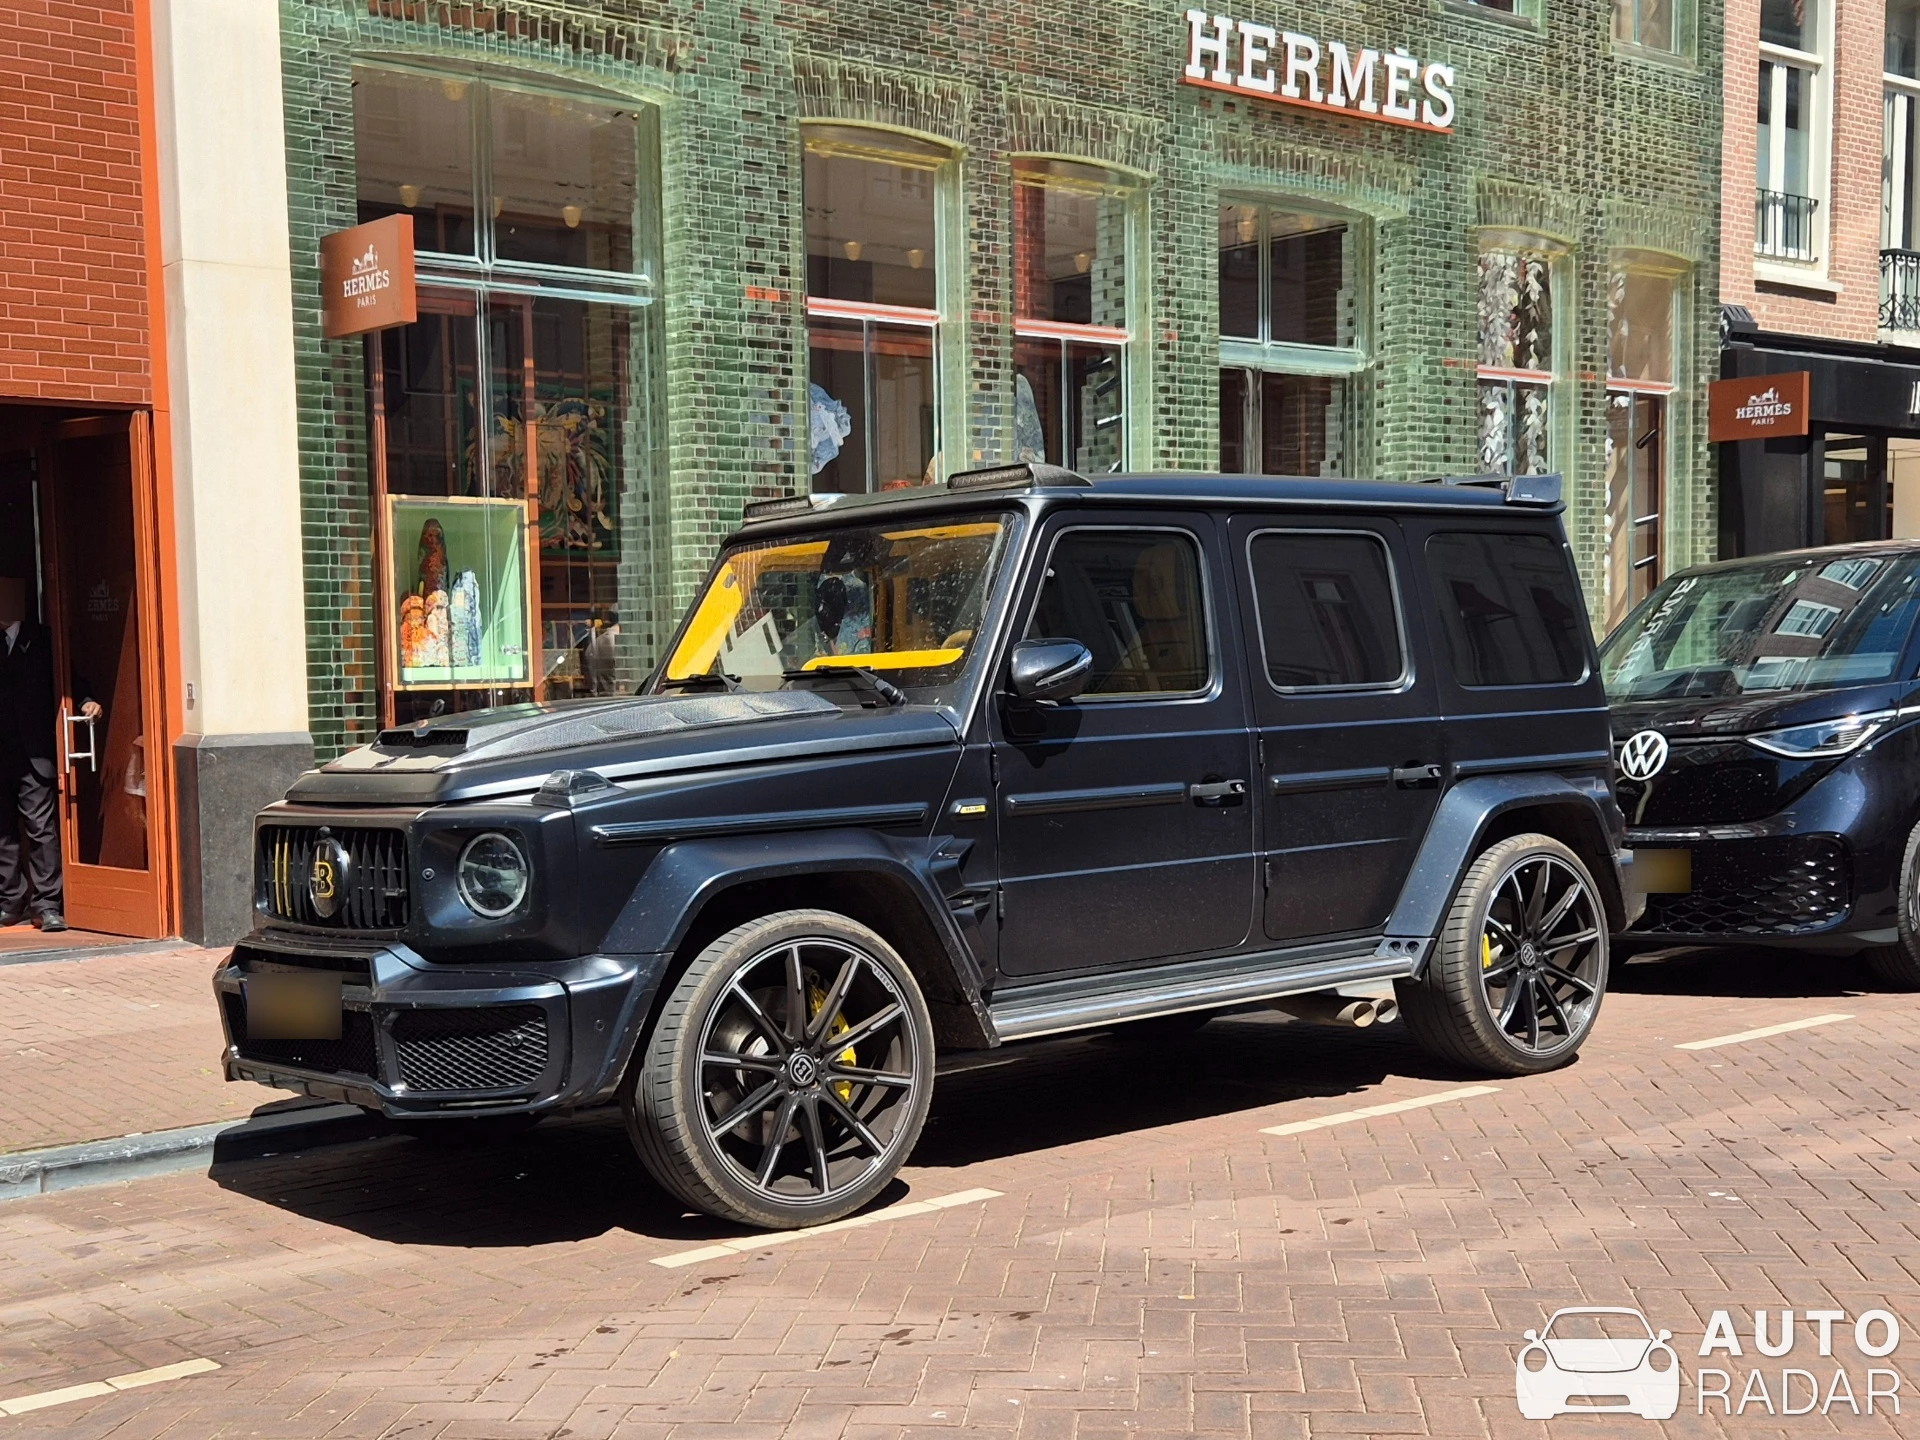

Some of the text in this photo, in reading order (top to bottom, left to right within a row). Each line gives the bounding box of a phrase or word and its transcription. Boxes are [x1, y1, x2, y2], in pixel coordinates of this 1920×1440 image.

[1184, 9, 1455, 128] HERMÈS
[343, 269, 390, 298] HERMÈS
[357, 294, 377, 309] PARIS
[1751, 416, 1775, 427] PARIS
[1620, 730, 1669, 781] VW
